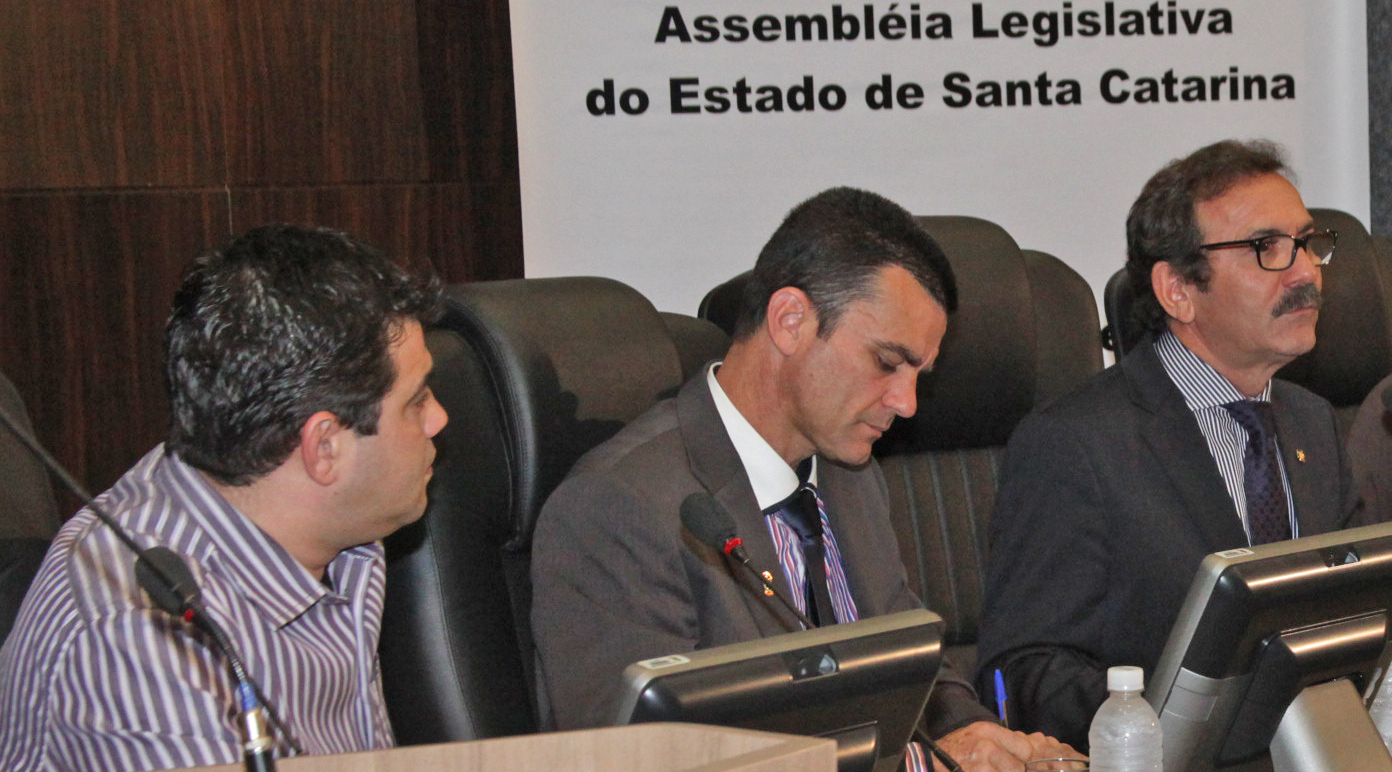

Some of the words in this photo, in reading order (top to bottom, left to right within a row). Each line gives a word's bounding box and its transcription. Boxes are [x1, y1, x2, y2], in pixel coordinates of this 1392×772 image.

[654, 3, 953, 44] Assembléia
[971, 0, 1233, 48] Legislativa
[586, 78, 650, 116] do
[669, 75, 848, 115] Estado
[864, 73, 925, 111] de
[942, 67, 1083, 109] Santa
[1099, 65, 1296, 105] Catarina
